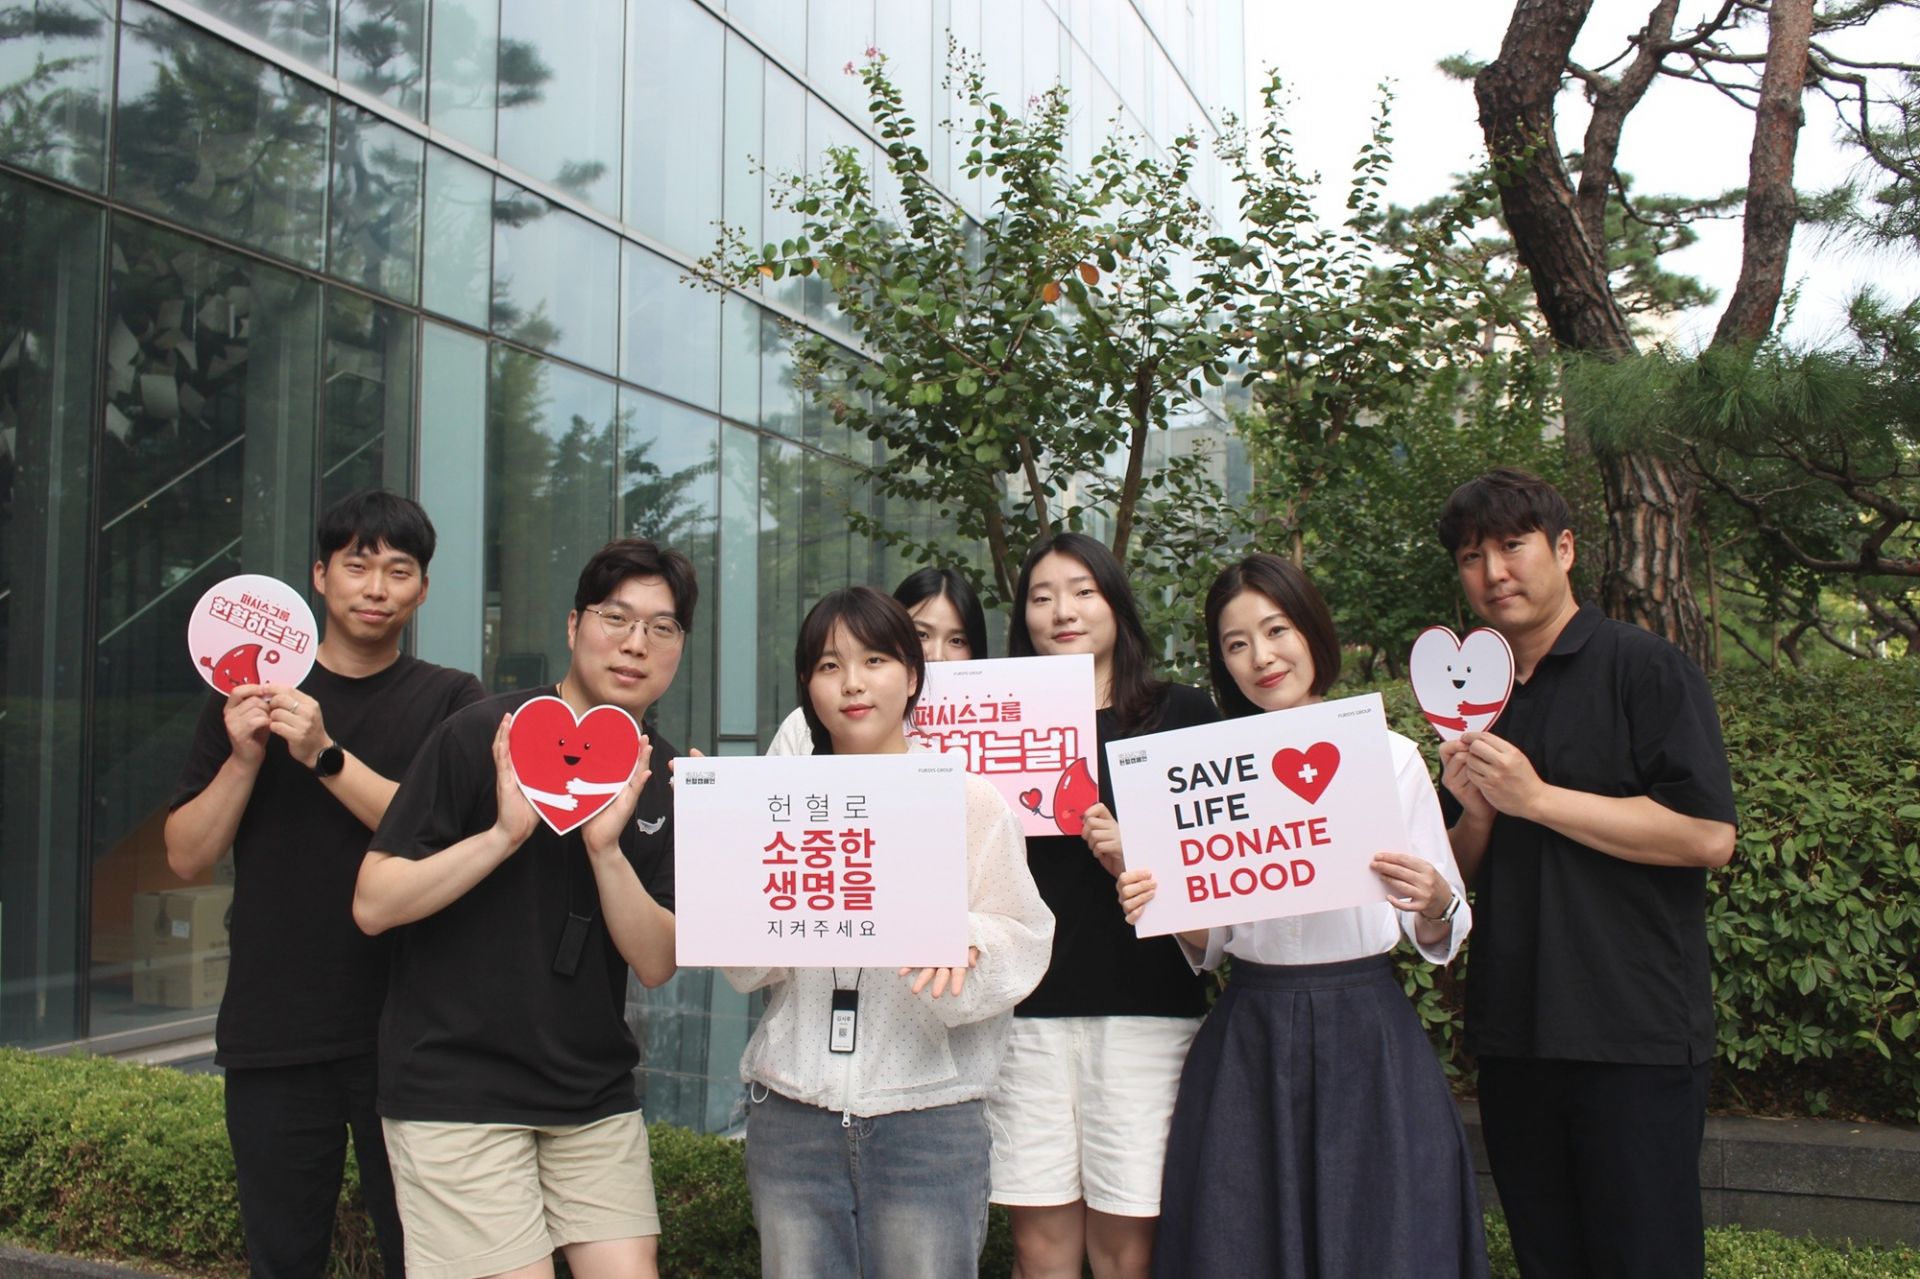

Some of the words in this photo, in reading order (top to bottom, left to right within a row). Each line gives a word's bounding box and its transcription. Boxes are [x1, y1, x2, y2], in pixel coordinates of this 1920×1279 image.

[914, 701, 1021, 726] 퍼시스그룹
[1167, 754, 1259, 793] SAVE
[767, 793, 869, 822] 헌혈로
[1174, 793, 1249, 829] LIFE
[762, 828, 876, 868] 소중한
[1180, 817, 1331, 866] DONATE
[762, 870, 876, 911] 생명을
[1186, 859, 1315, 902] BLOOD
[767, 920, 876, 938] 지켜주세요
